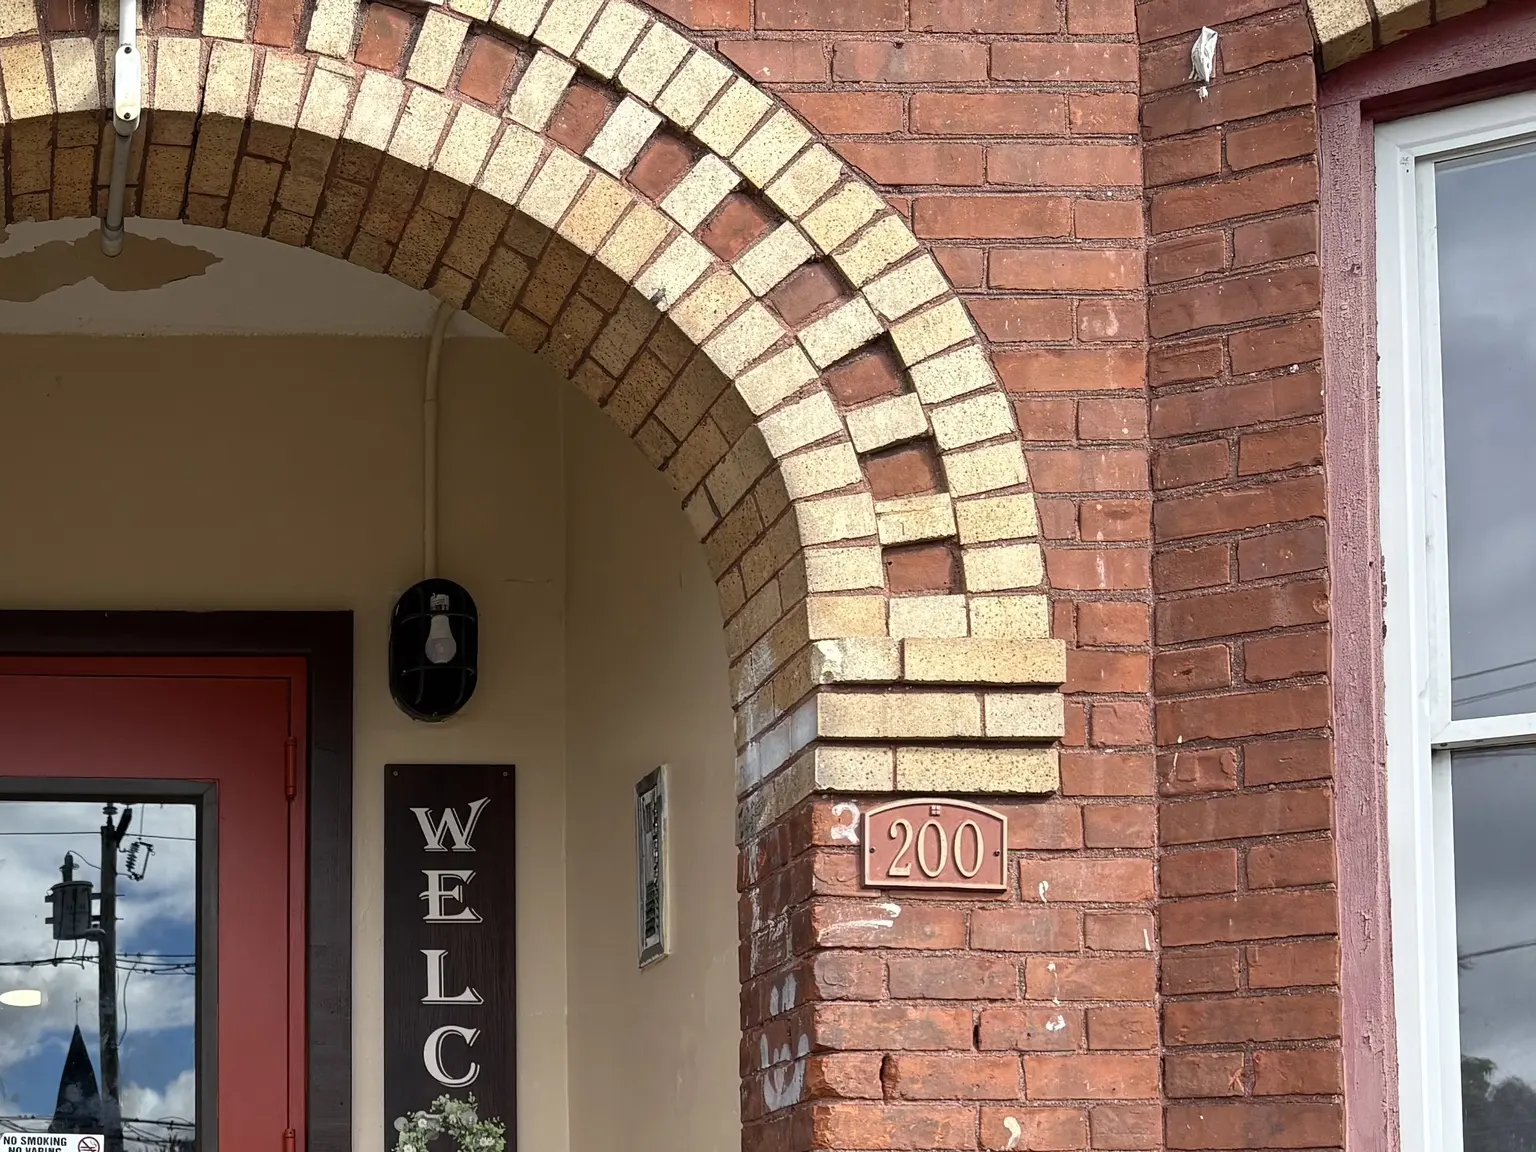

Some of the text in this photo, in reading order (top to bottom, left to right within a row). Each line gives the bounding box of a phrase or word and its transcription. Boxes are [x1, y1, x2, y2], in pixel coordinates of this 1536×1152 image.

[888, 818, 984, 878] 200
[3, 1136, 67, 1146] NO SMOKING
